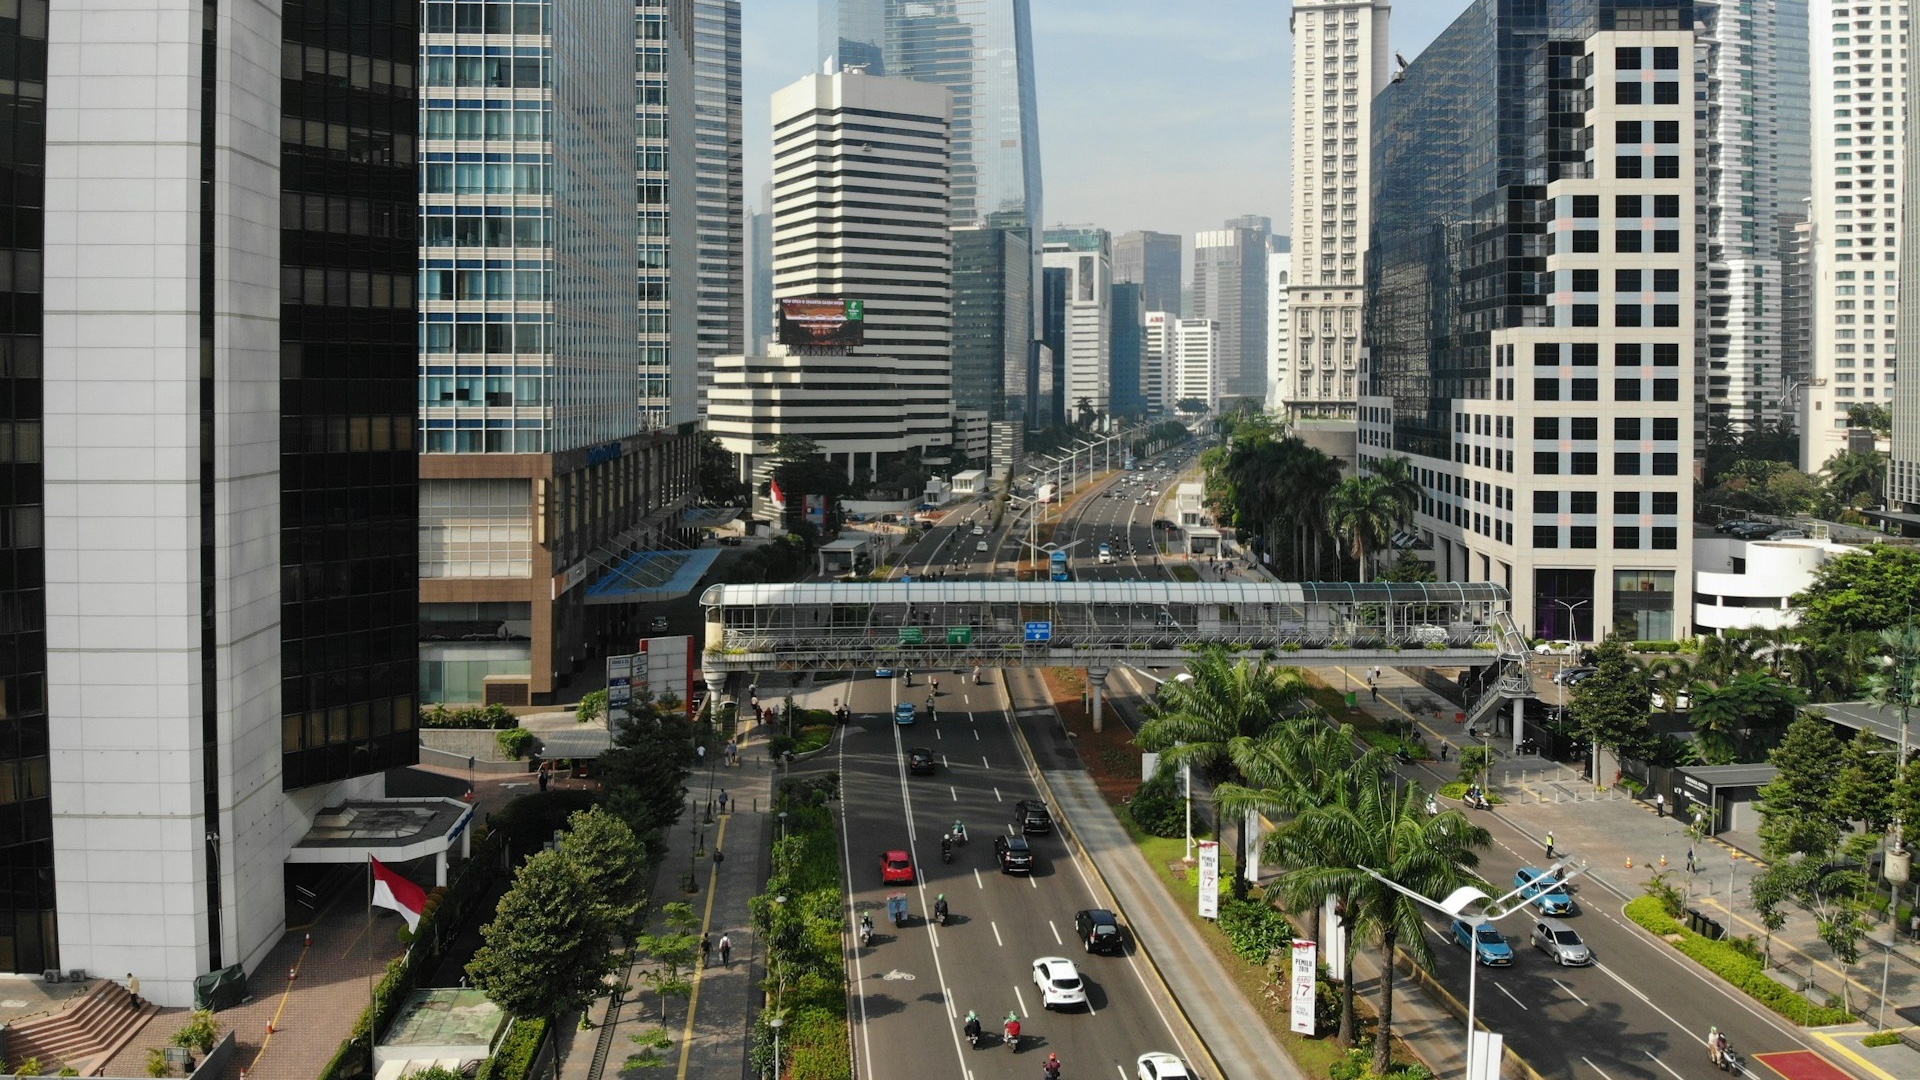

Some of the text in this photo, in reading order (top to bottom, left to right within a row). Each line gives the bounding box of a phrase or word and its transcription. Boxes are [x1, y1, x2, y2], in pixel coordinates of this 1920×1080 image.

[1203, 876, 1214, 887] 17
[1295, 958, 1312, 967] PEMILU
[1296, 983, 1311, 997] 17
